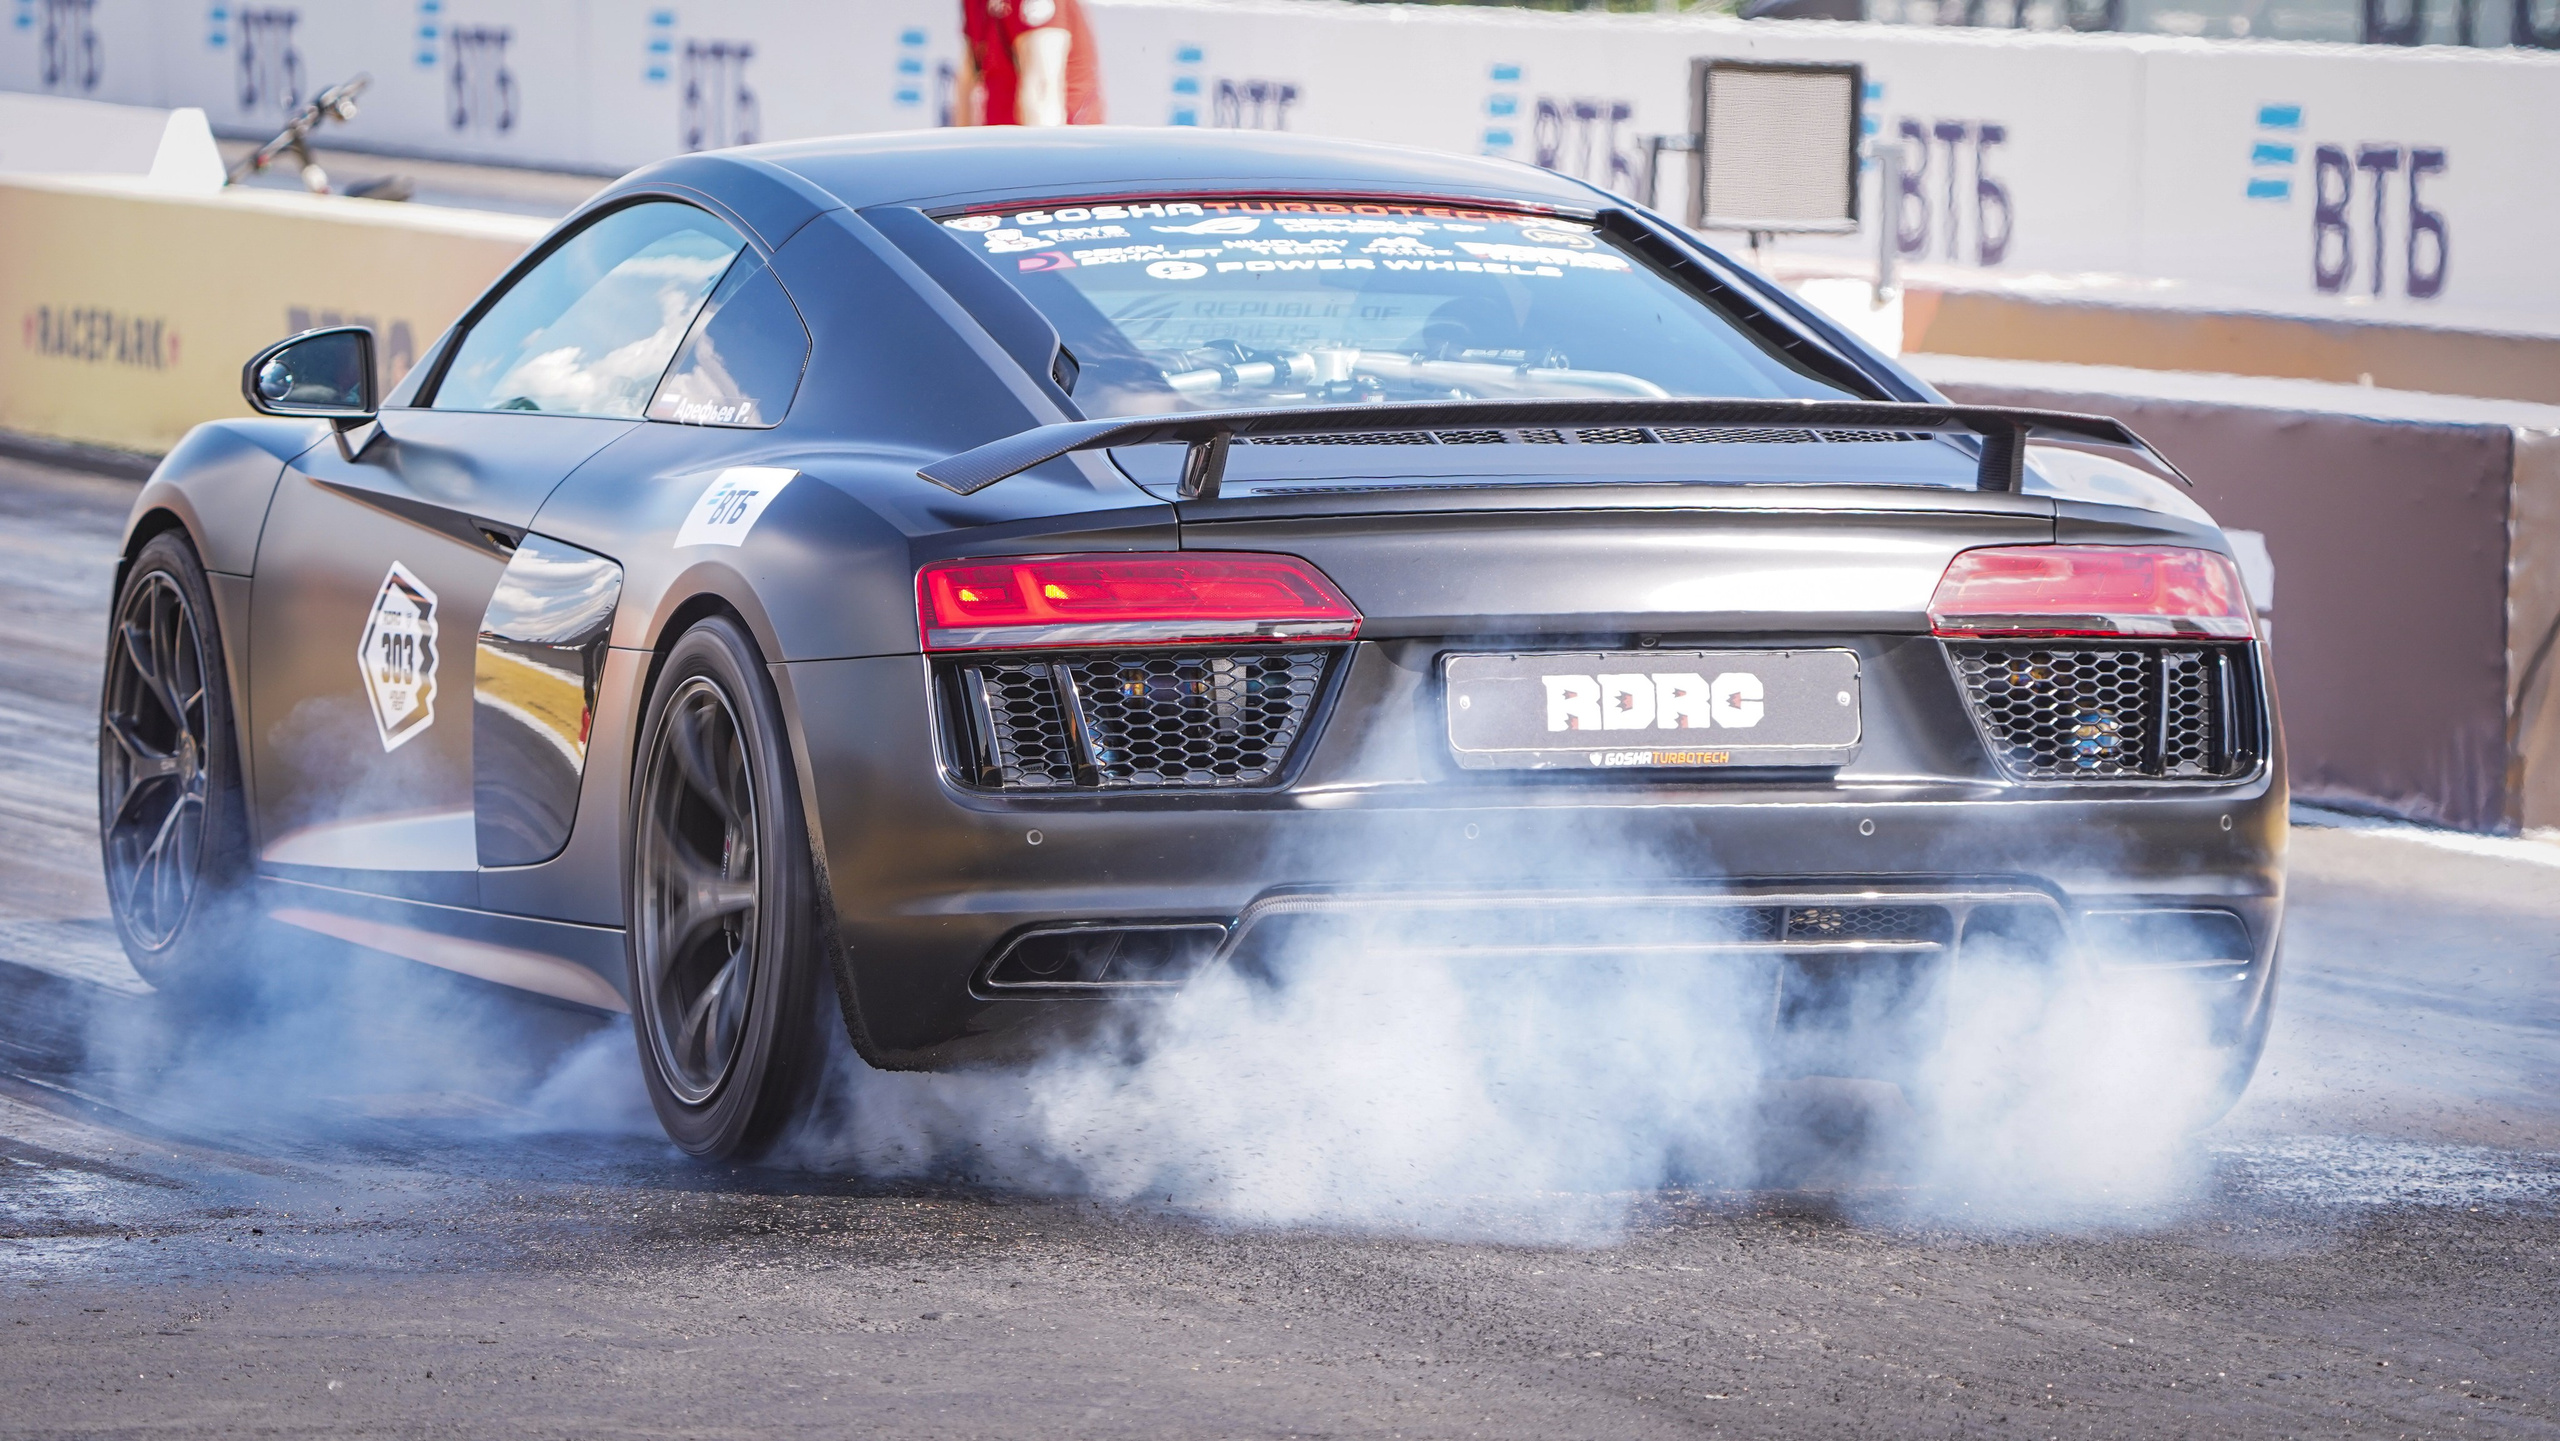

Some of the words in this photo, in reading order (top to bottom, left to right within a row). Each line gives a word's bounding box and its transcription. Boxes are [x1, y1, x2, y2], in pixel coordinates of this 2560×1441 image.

[1897, 121, 2012, 267] ВТБ
[2314, 143, 2449, 298] ВТБ
[1216, 258, 1376, 273] POWER
[1382, 259, 1563, 277] WHEELS
[707, 490, 759, 525] ВТБ
[382, 632, 413, 685] 303
[1542, 672, 1765, 732] RDRC
[1604, 751, 1730, 766] GOSHATURBOTECH
